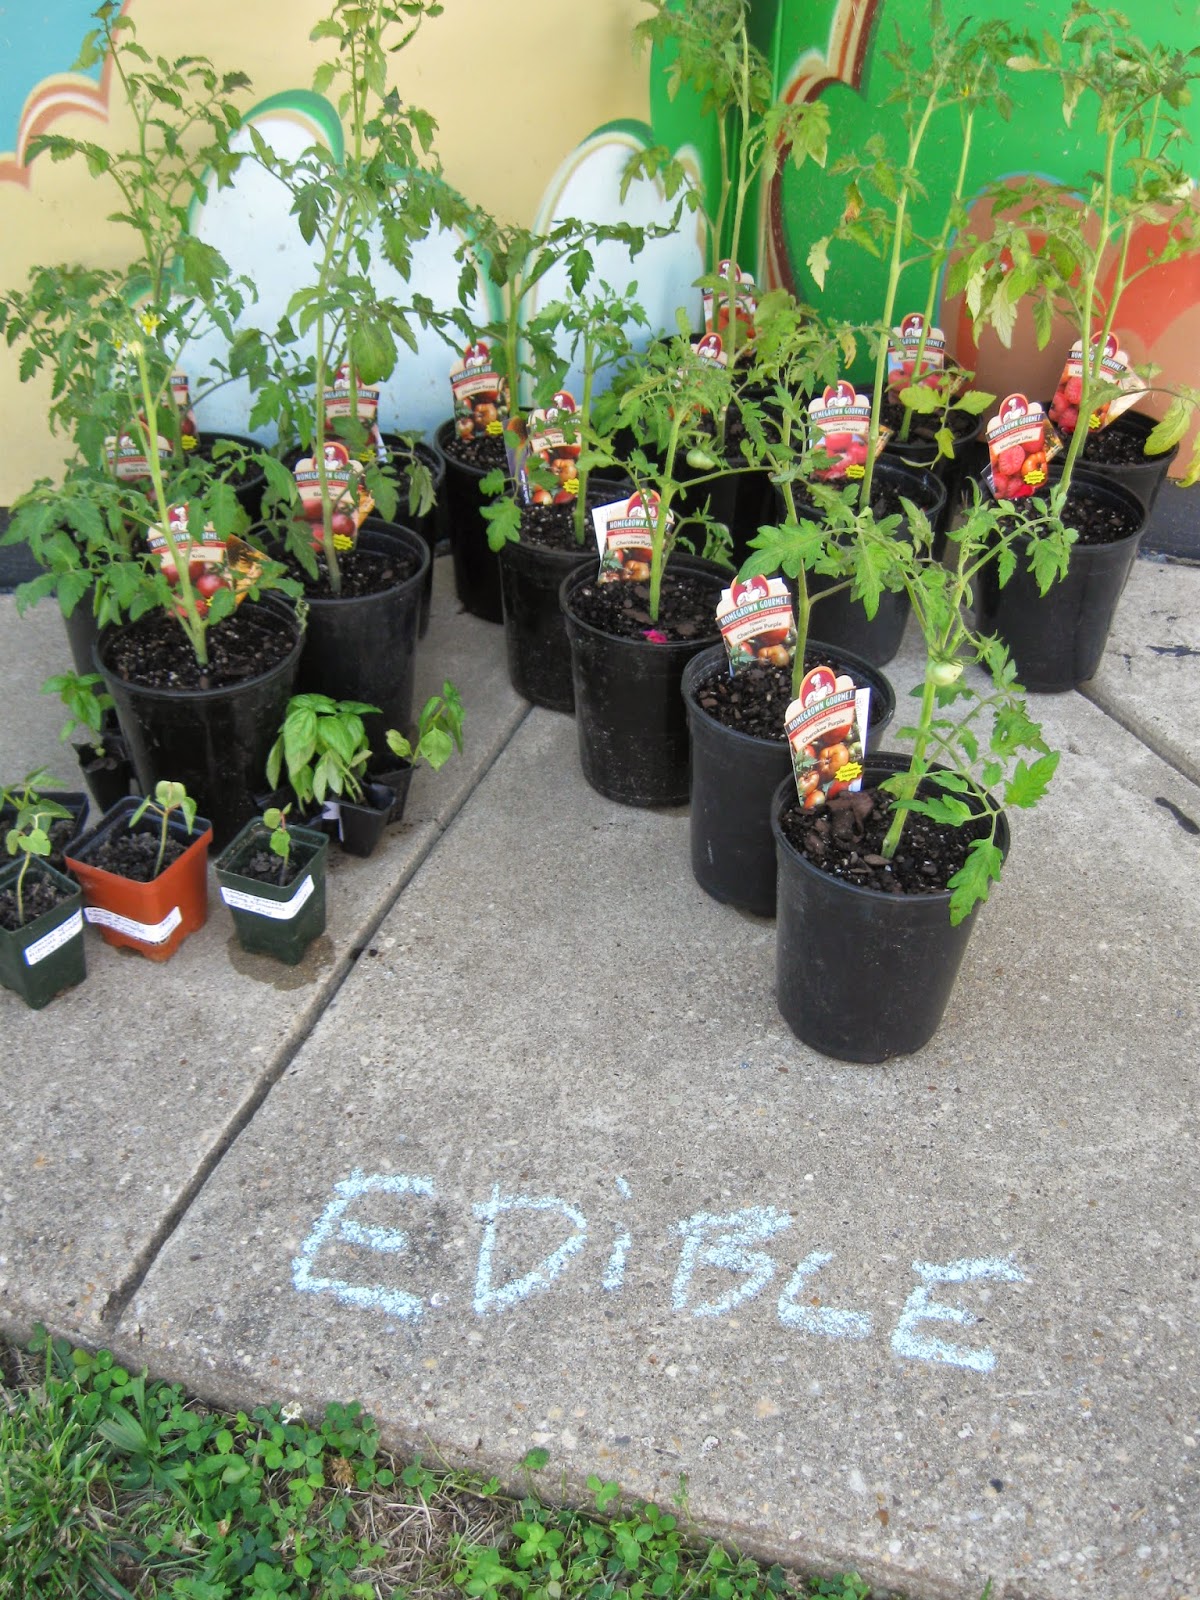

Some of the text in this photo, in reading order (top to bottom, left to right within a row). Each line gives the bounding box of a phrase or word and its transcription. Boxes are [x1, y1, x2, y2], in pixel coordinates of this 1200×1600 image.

[811, 408, 843, 420] HOMEGROWN
[610, 519, 644, 529] HOMEGROWN
[721, 596, 787, 625] HOMEGROWN GOURMET
[737, 621, 782, 639] Cherokee Purple
[789, 690, 853, 730] HOMEGROWN GOURMET
[802, 719, 846, 743] Cherokee Purple
